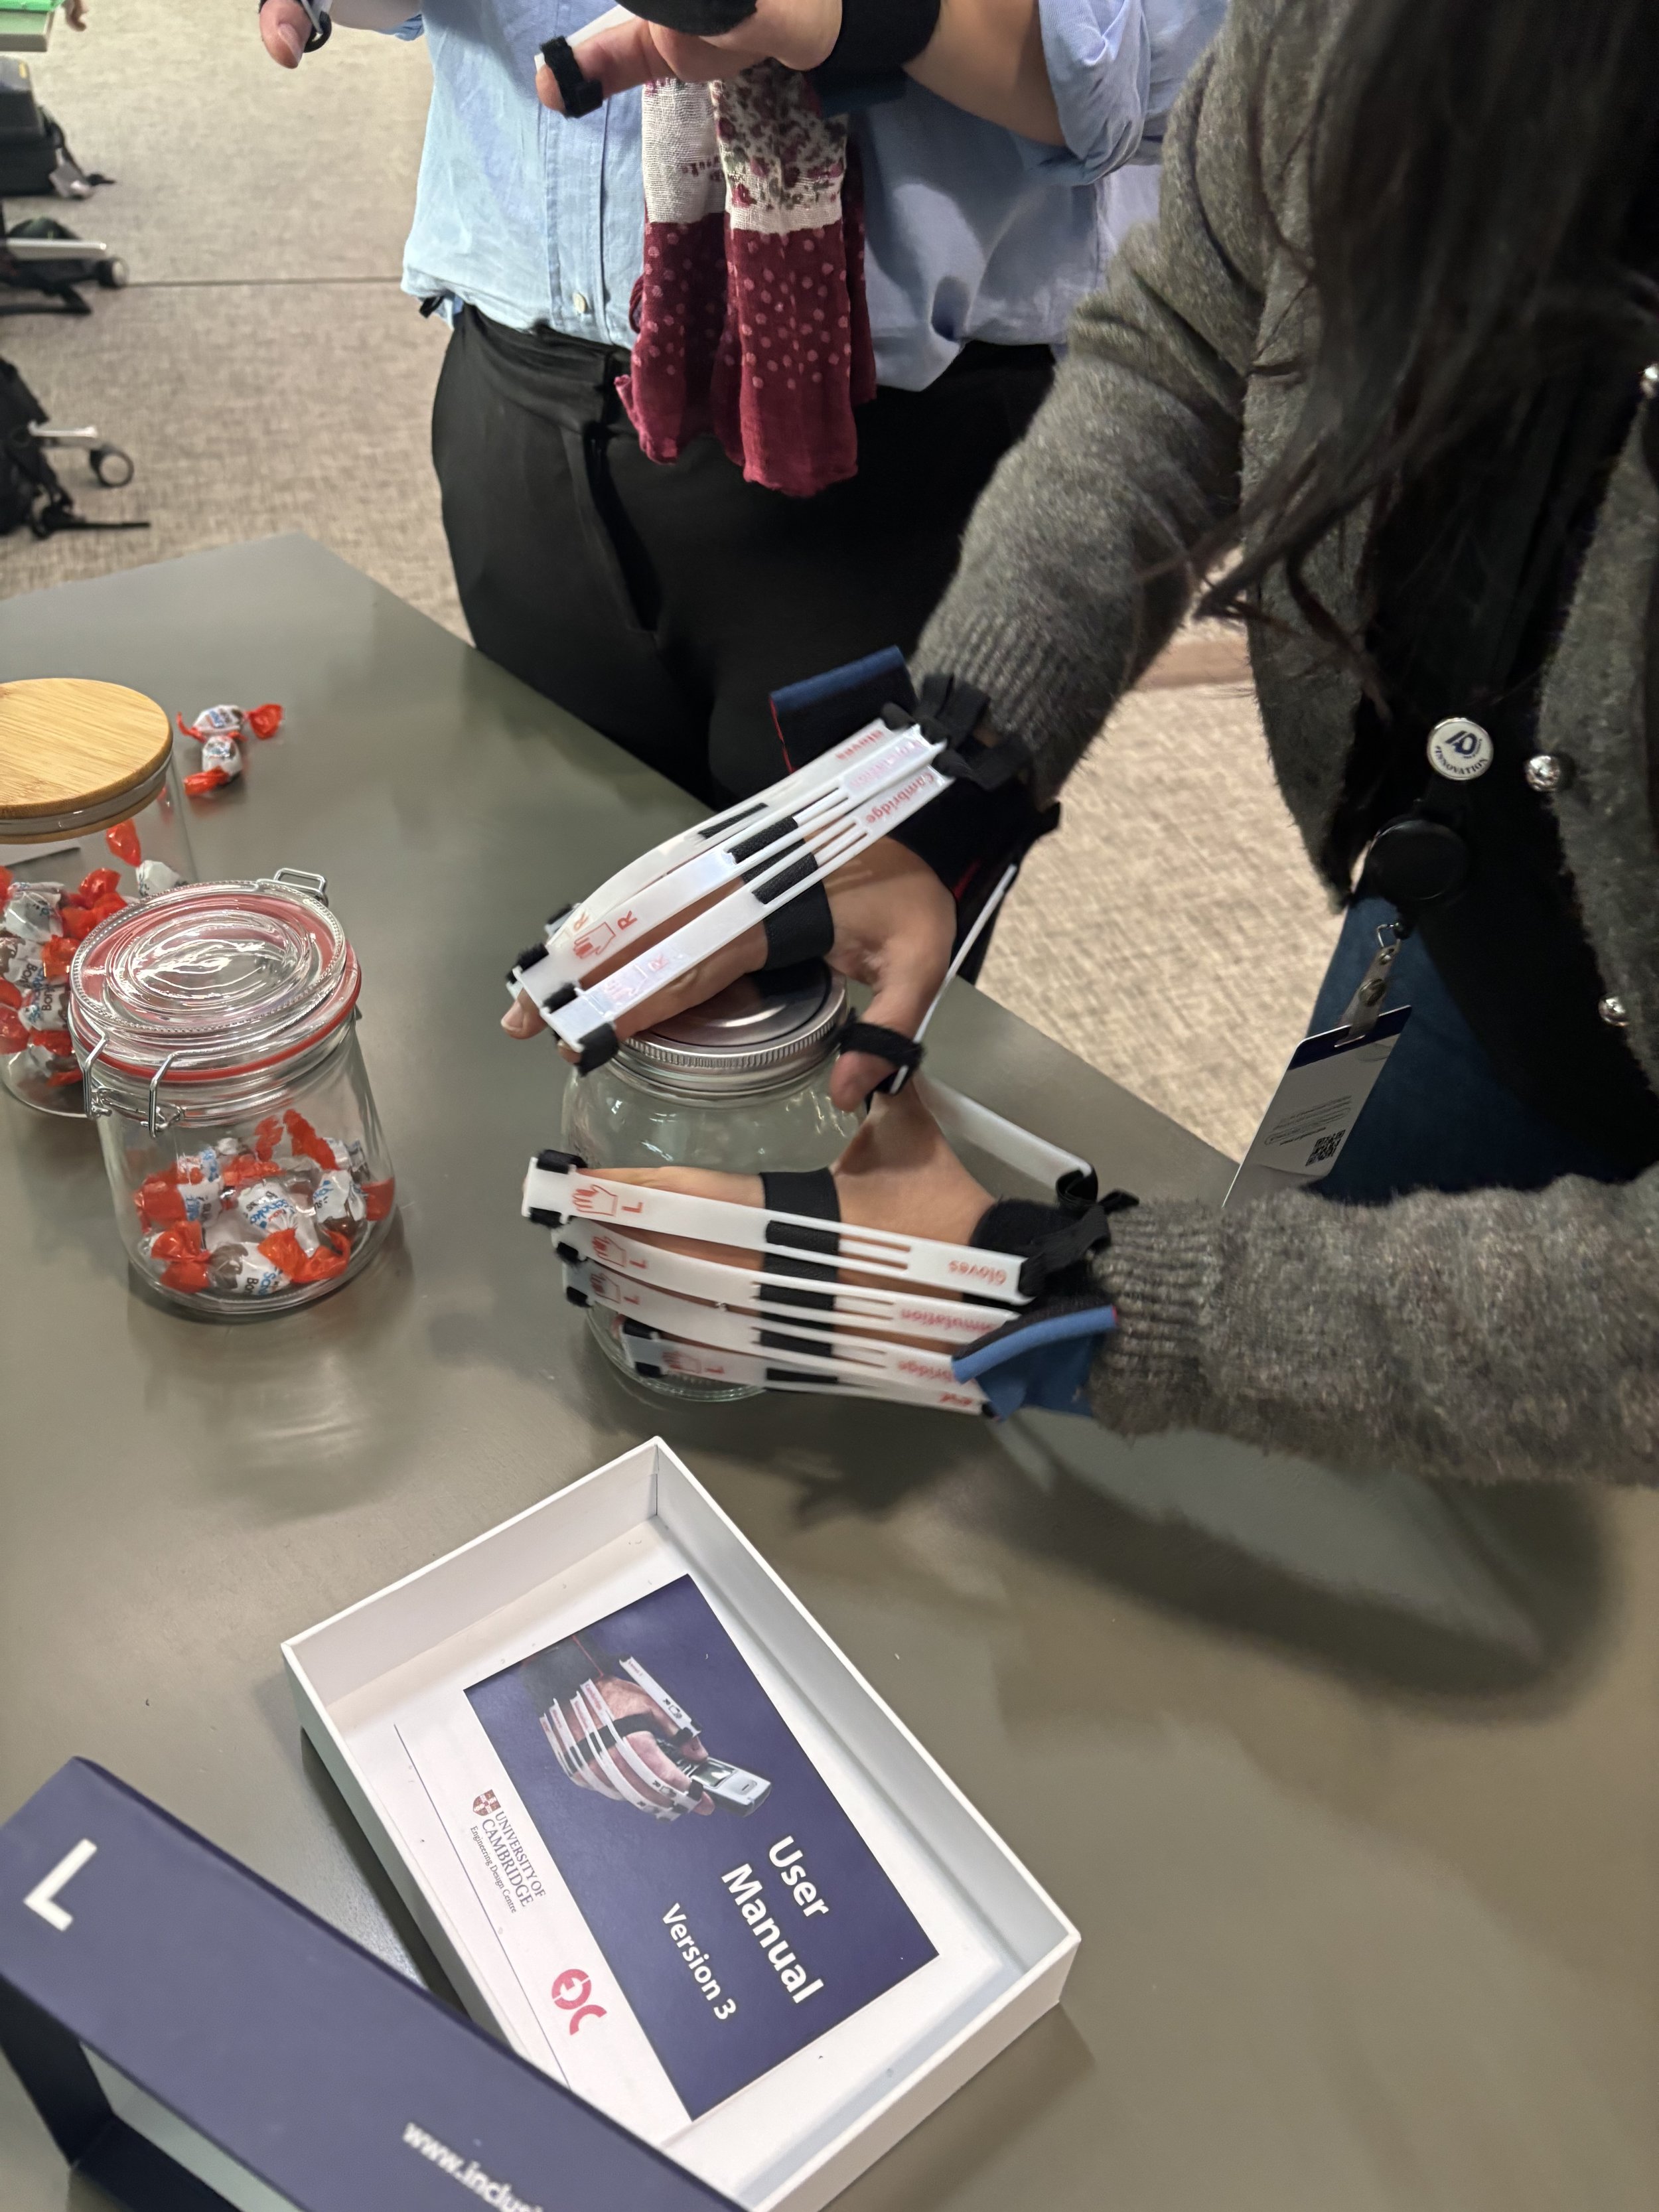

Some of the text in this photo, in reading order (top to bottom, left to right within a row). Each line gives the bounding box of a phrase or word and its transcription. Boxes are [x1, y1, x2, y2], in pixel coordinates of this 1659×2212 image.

[865, 771, 934, 823] Cambridge
[617, 911, 638, 930] R
[621, 1202, 643, 1213] L
[629, 1260, 646, 1269] L
[23, 1837, 98, 1931] L
[470, 1826, 518, 1913] Engineering Design Centre
[482, 1818, 534, 1907] CAMBRIDGE
[495, 1810, 546, 1898] UNIVERSITY OF
[769, 1836, 829, 1917] User
[662, 1903, 736, 2020] Version 3
[721, 1863, 824, 2004] Manual
